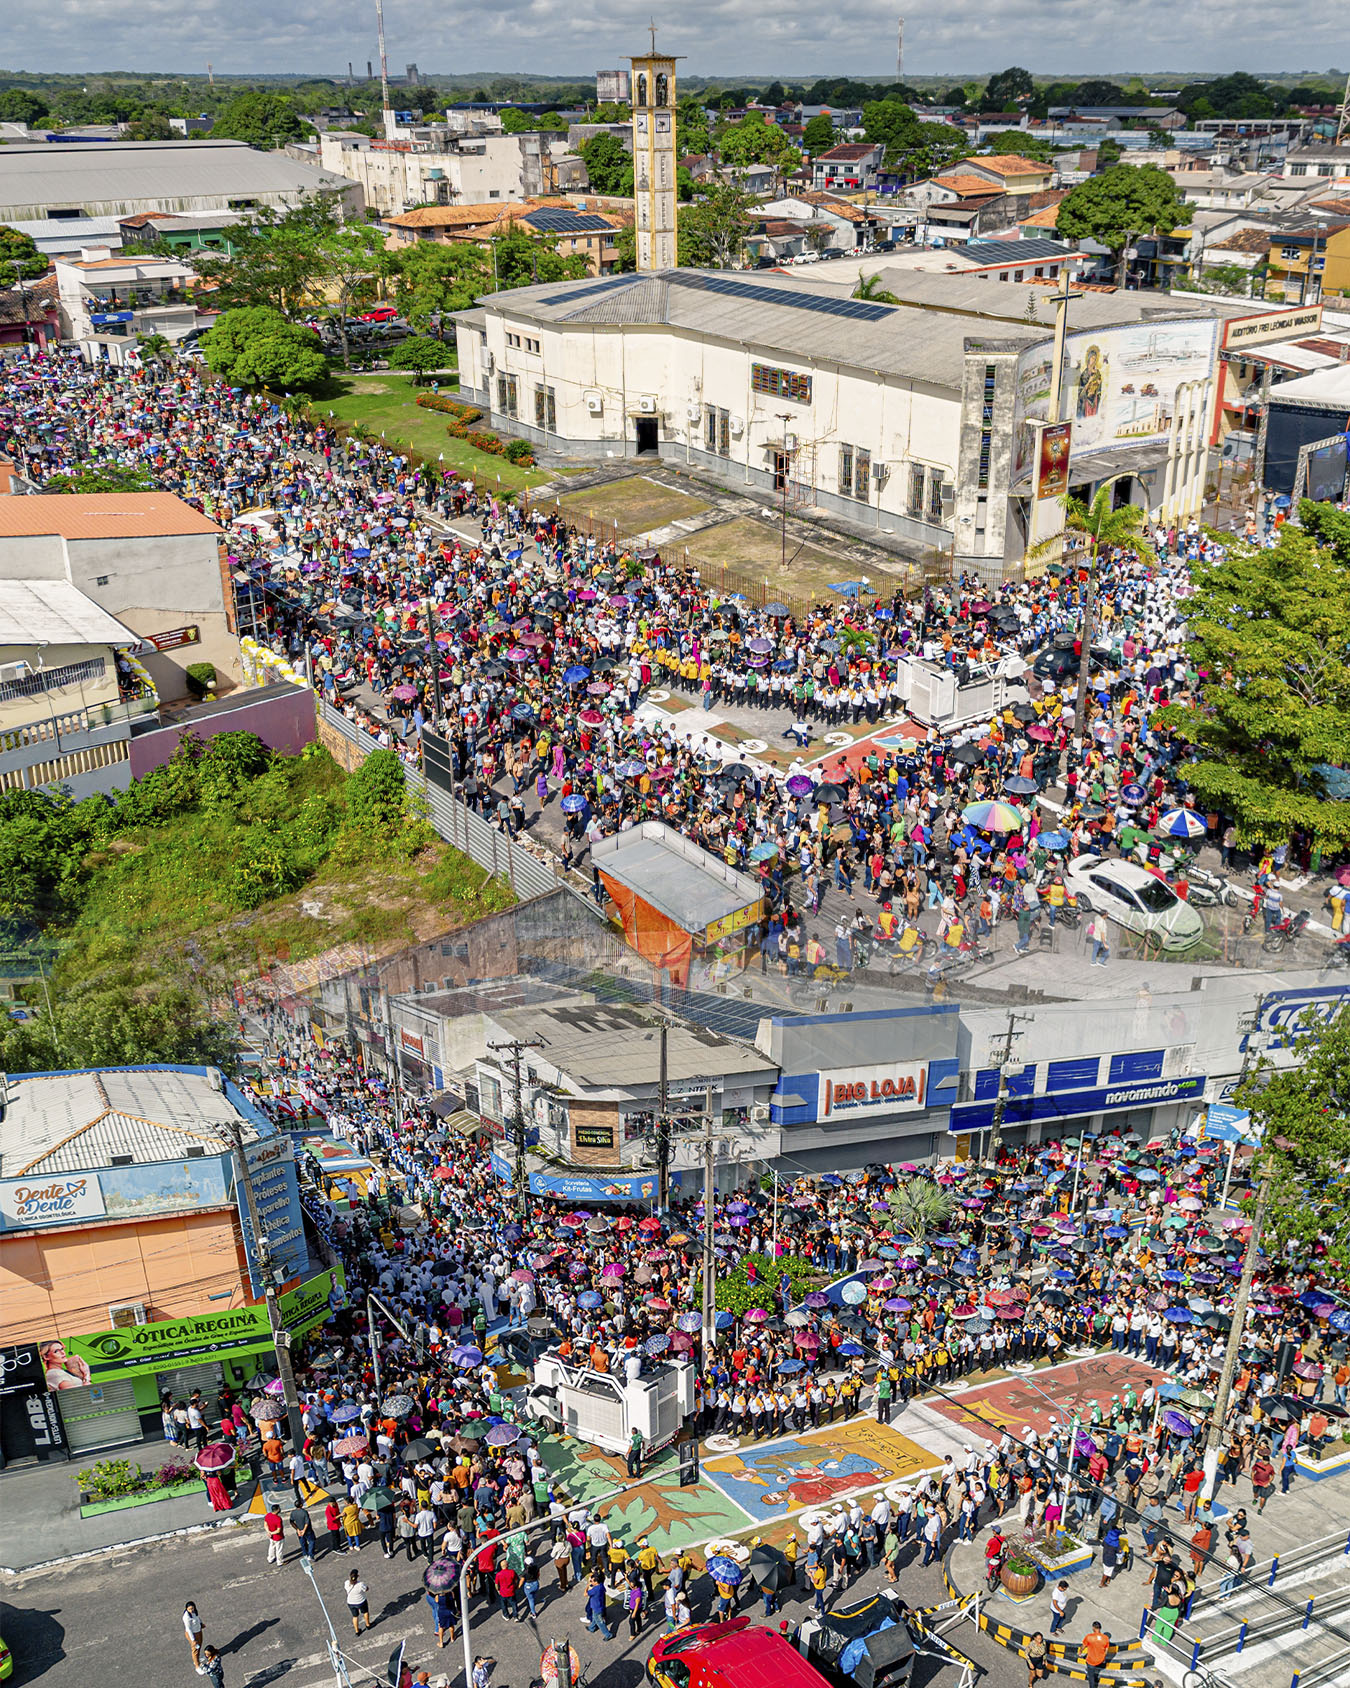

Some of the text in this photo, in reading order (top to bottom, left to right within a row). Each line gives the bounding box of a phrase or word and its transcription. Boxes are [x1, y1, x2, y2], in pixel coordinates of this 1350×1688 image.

[833, 1075, 916, 1103] BIG LOJA
[14, 1183, 65, 1204] Dente
[135, 1313, 259, 1345] ÓTICA REGINA
[26, 1399, 51, 1446] LAB
